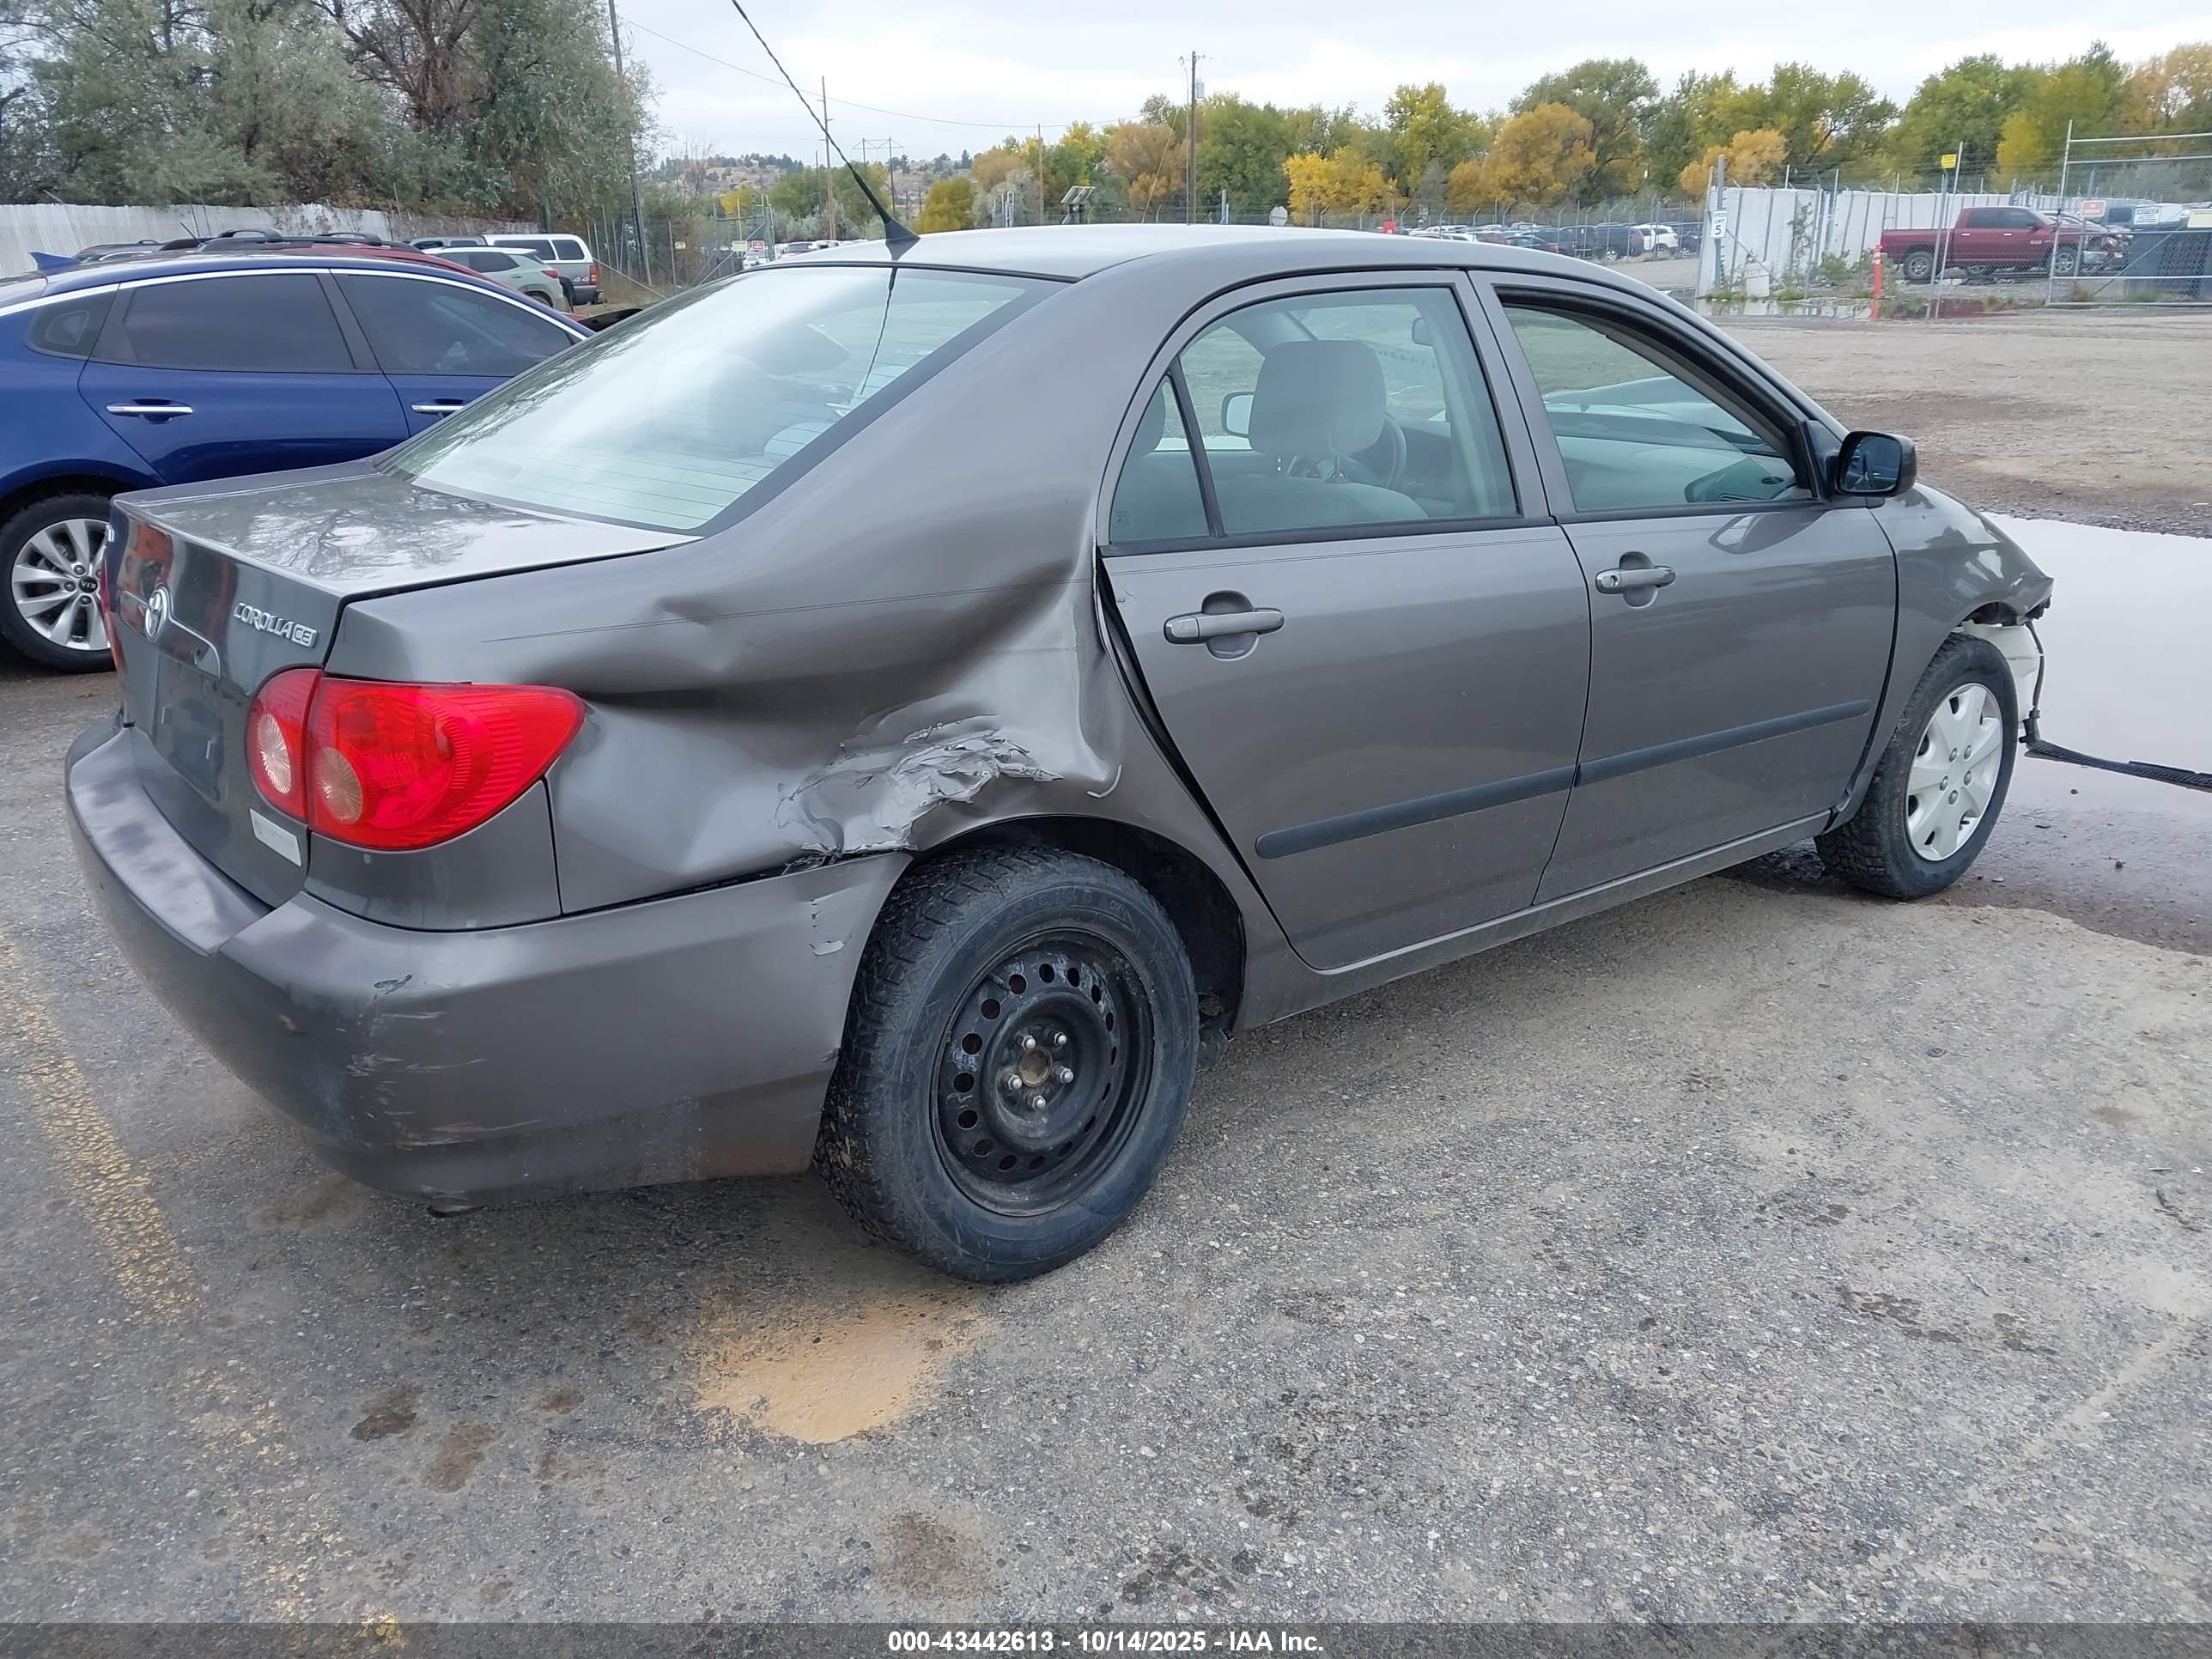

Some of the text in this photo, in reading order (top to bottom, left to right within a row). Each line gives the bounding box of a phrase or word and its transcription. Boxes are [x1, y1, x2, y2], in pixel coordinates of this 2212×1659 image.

[1714, 225, 1722, 235] 5
[233, 602, 314, 646] COROLLA CE
